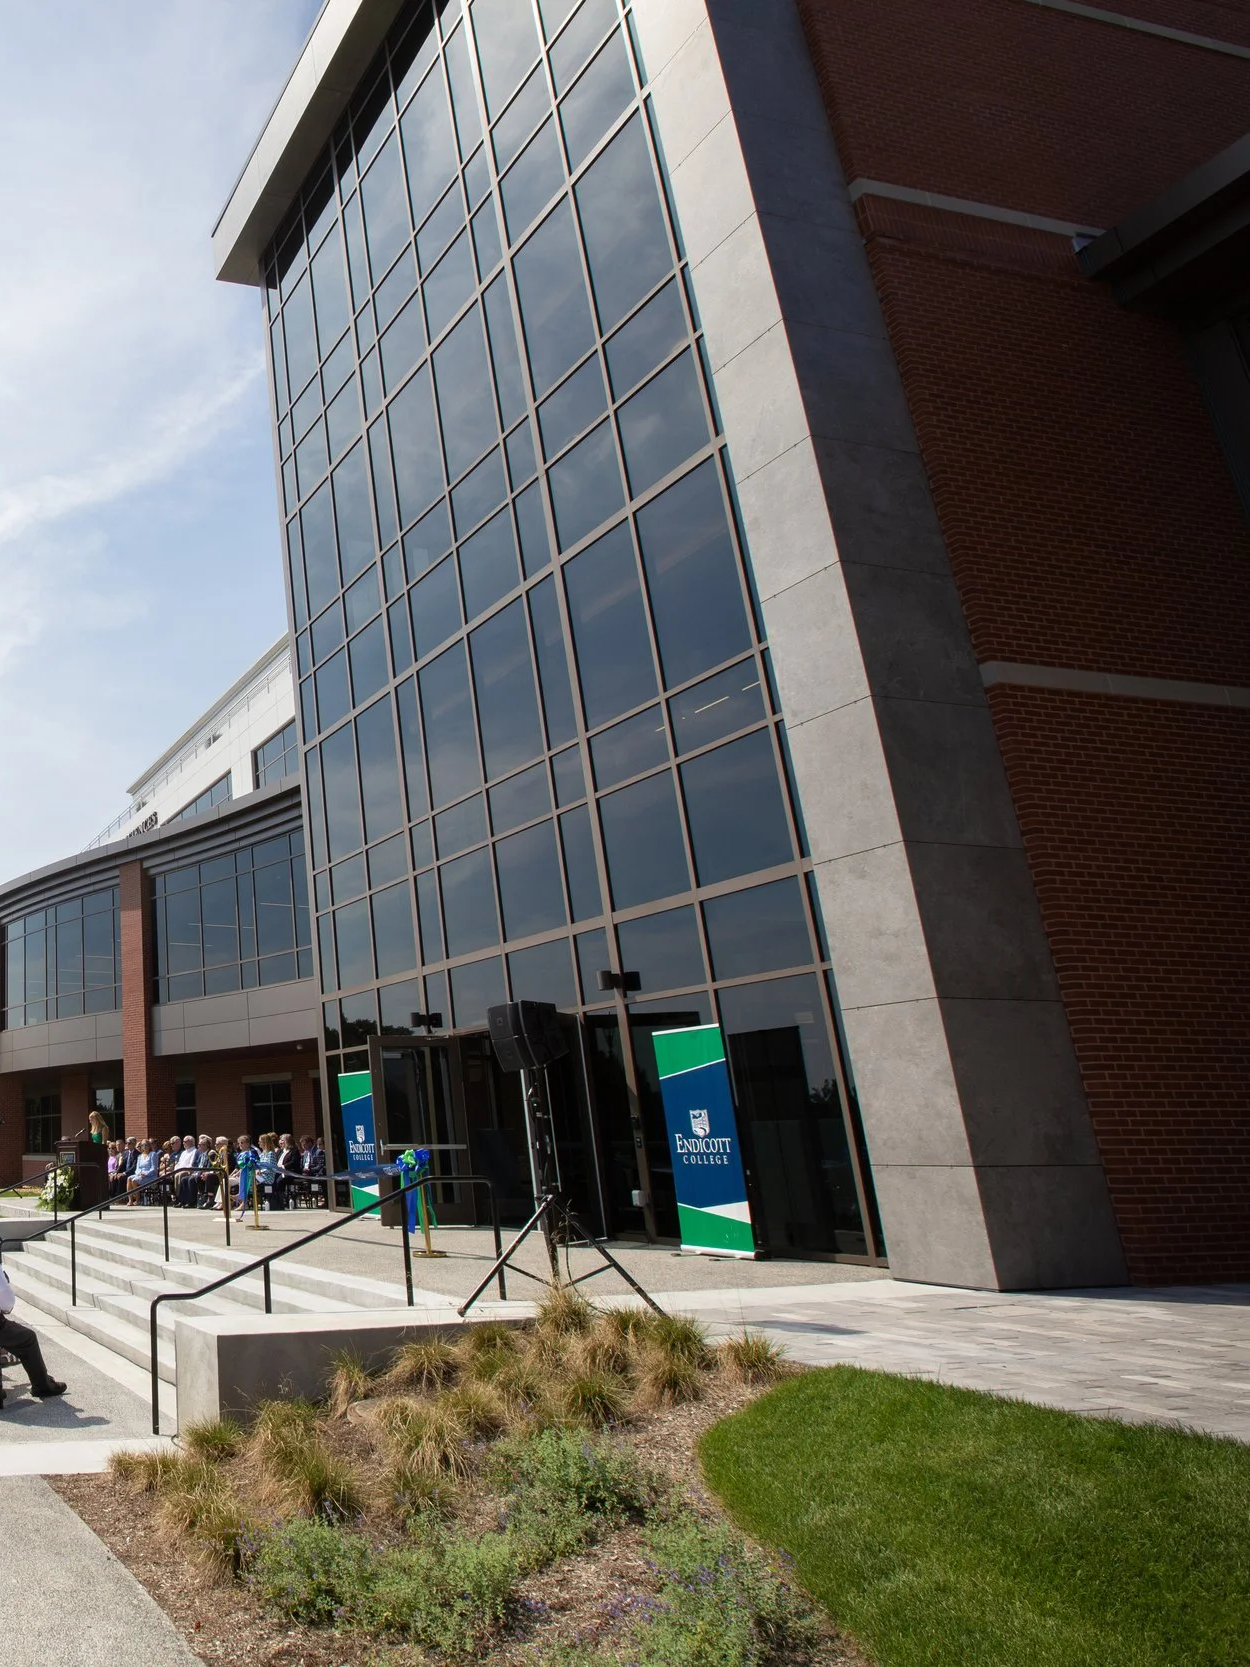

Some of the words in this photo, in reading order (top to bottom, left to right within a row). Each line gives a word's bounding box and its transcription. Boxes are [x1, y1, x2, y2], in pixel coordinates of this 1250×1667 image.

[348, 1140, 375, 1154] ENDICOTT
[674, 1133, 731, 1153] ENDICOTT
[683, 1155, 729, 1165] COLLEGE
